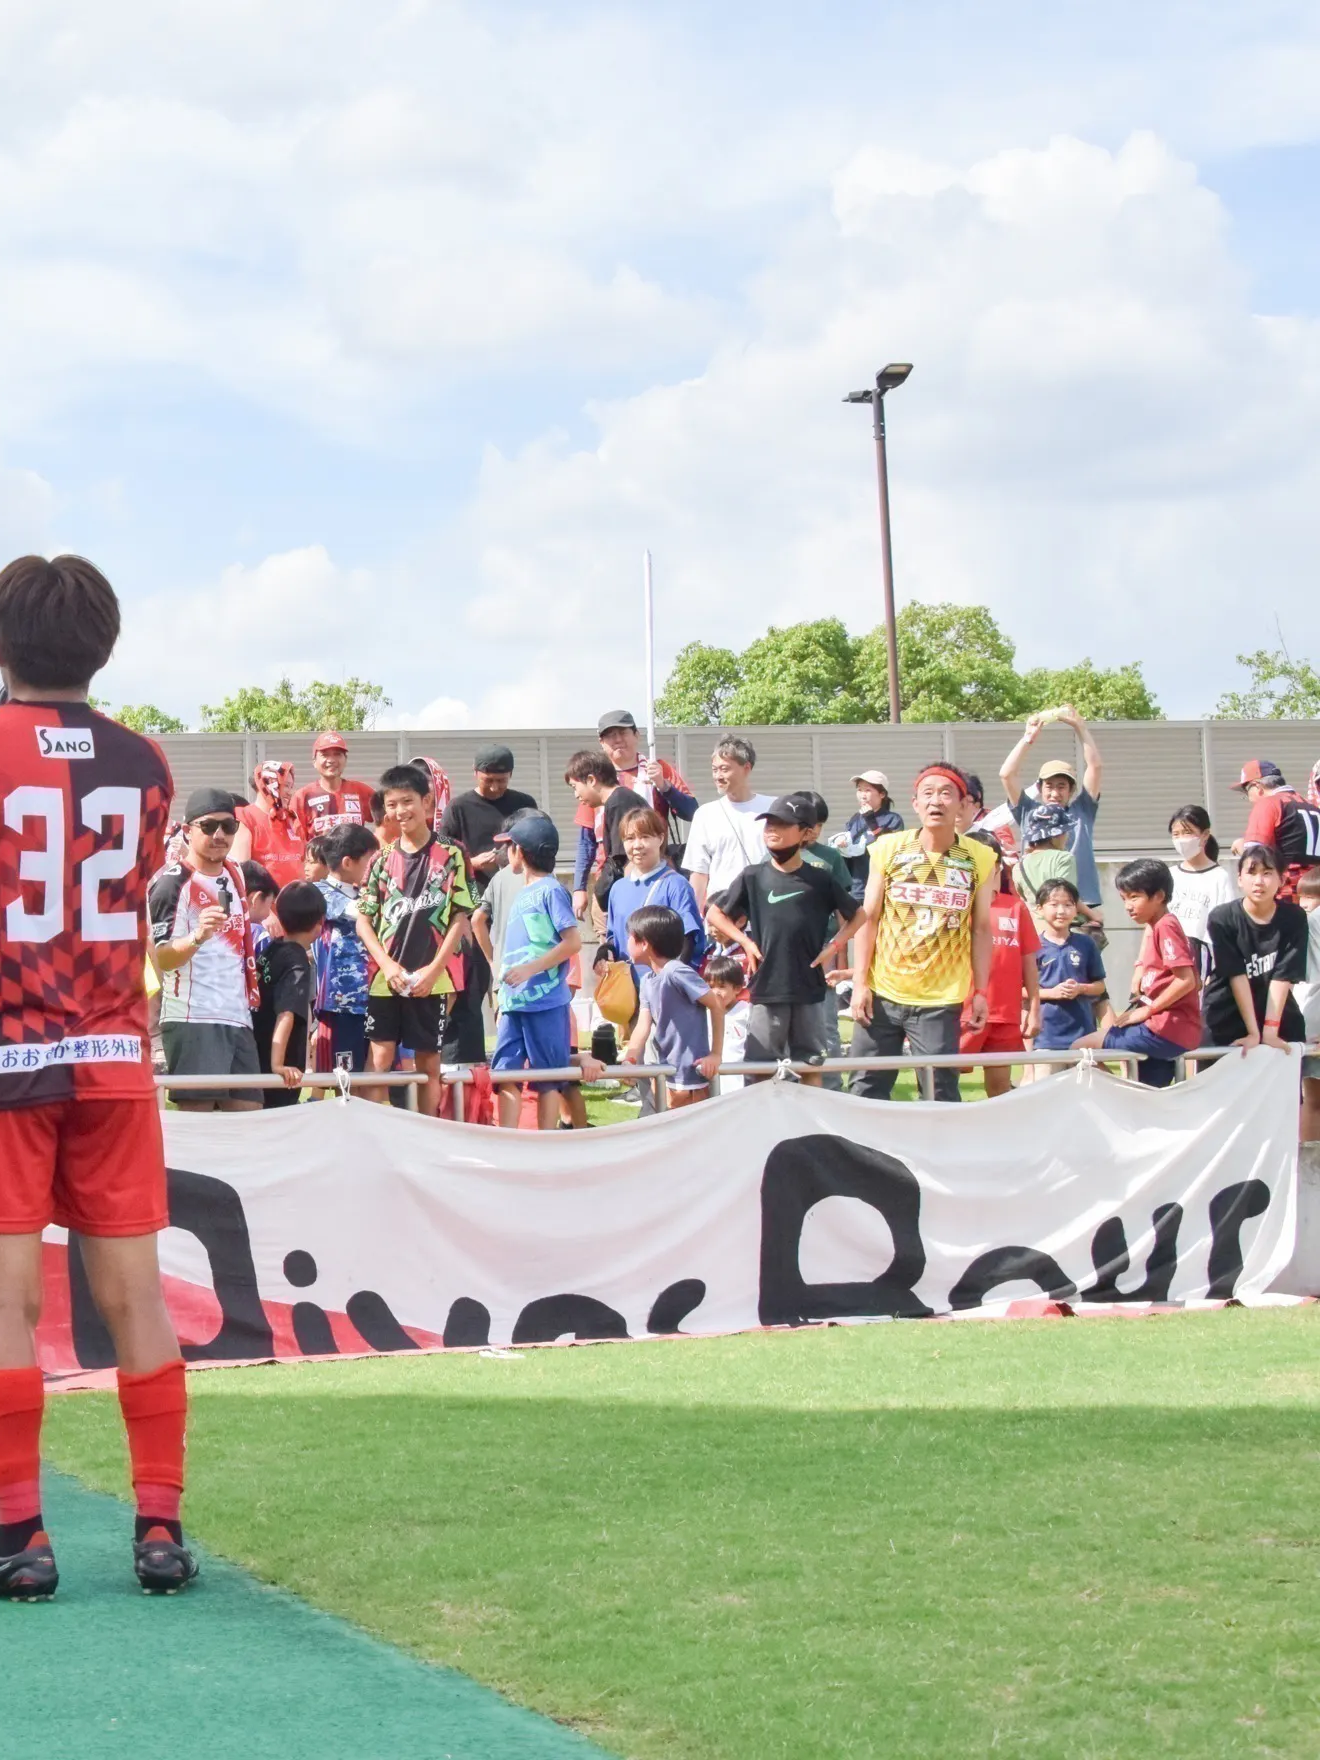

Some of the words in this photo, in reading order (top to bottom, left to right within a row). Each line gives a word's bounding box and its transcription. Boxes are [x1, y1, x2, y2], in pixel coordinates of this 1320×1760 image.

[40, 729, 91, 755] SANO
[3, 785, 142, 944] 32
[892, 884, 968, 909] スギ薬局
